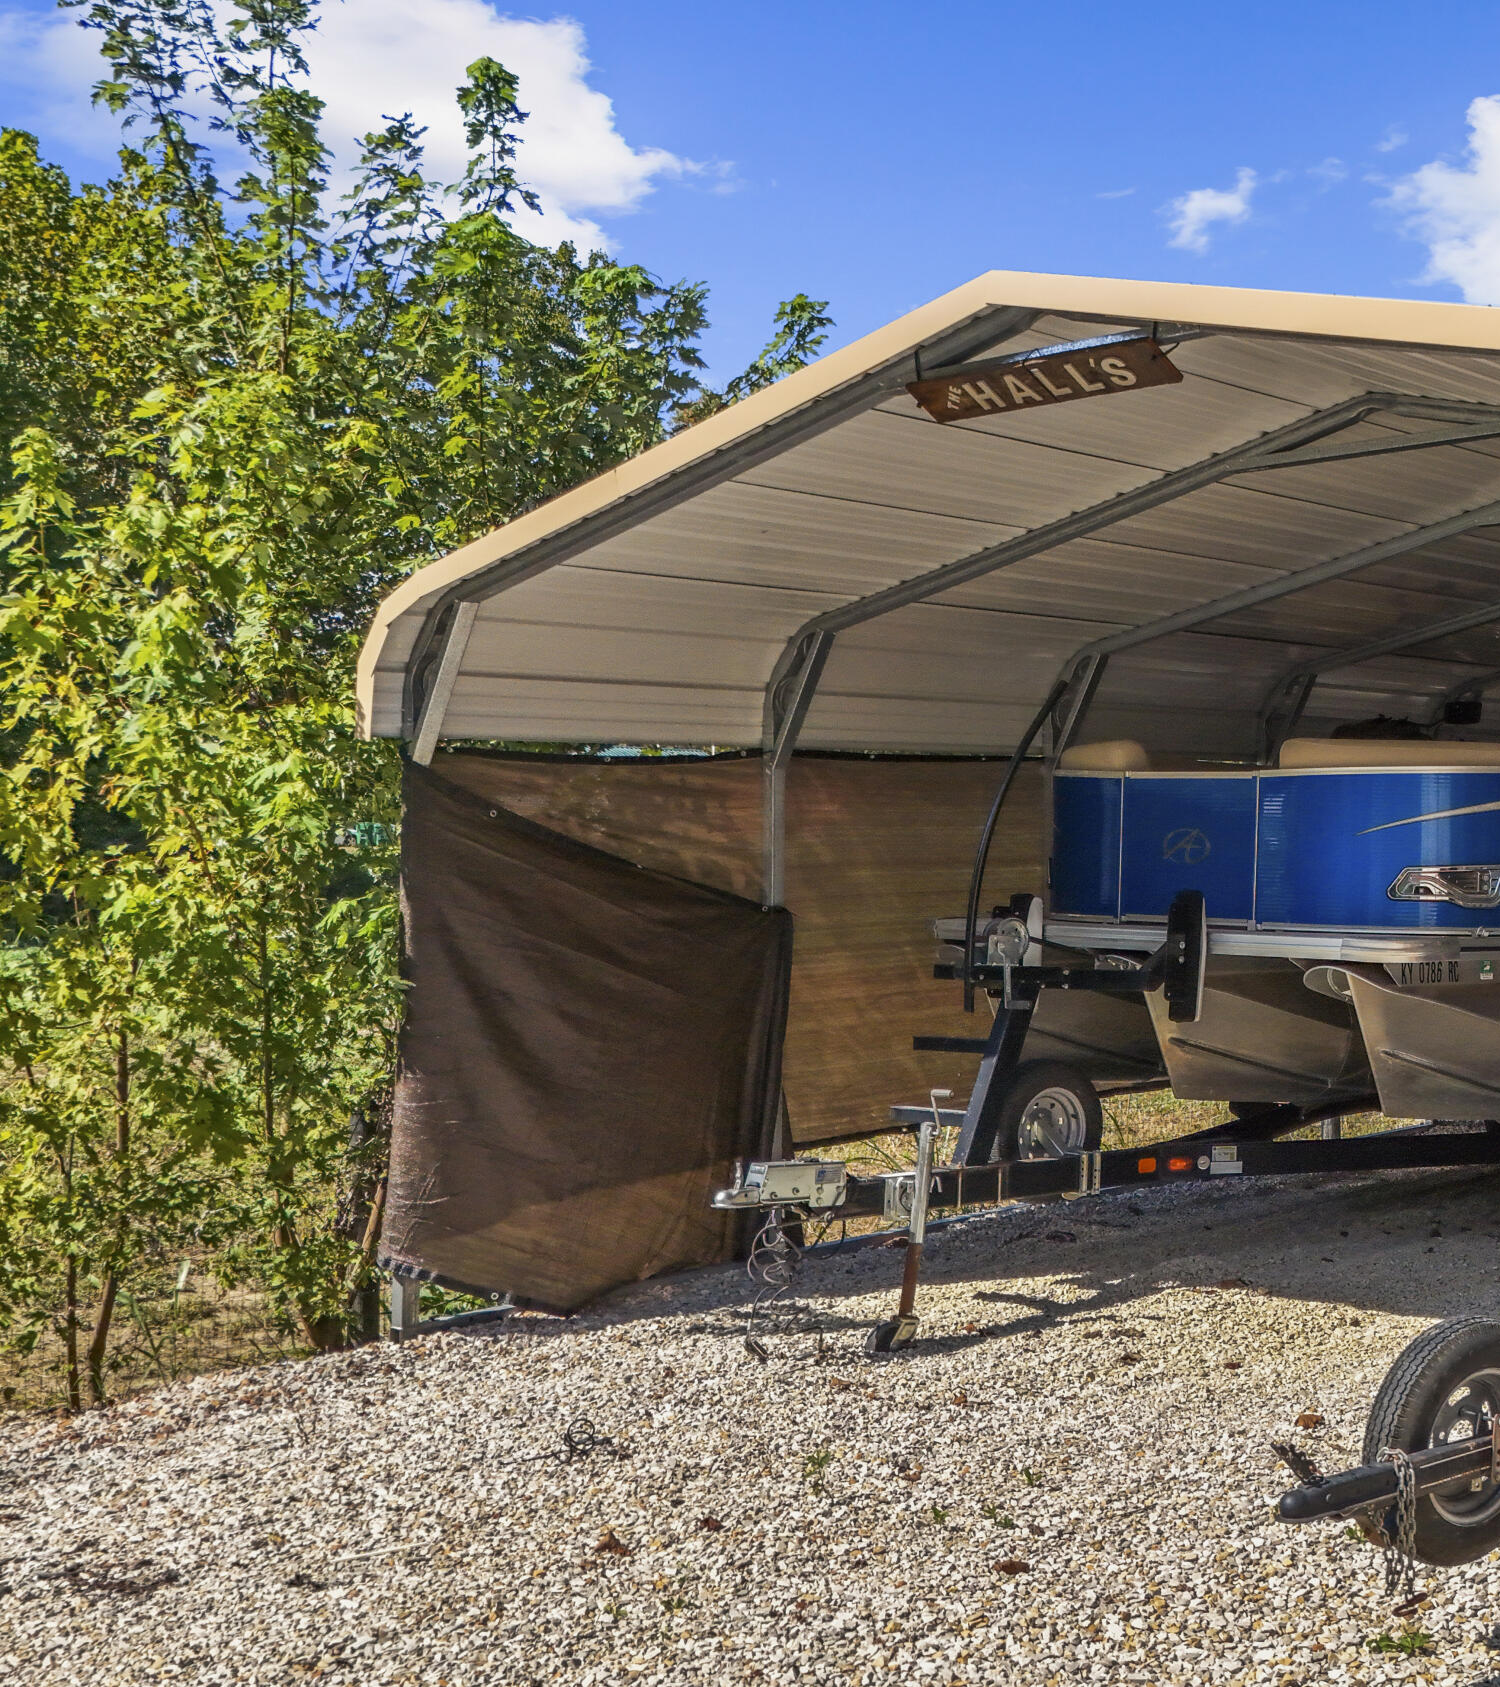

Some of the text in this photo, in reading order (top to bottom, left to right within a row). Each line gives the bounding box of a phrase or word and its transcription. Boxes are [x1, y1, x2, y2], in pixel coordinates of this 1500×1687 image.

[947, 356, 1138, 411] THE HALL'S
[1401, 961, 1460, 984] KY 0786 RC
